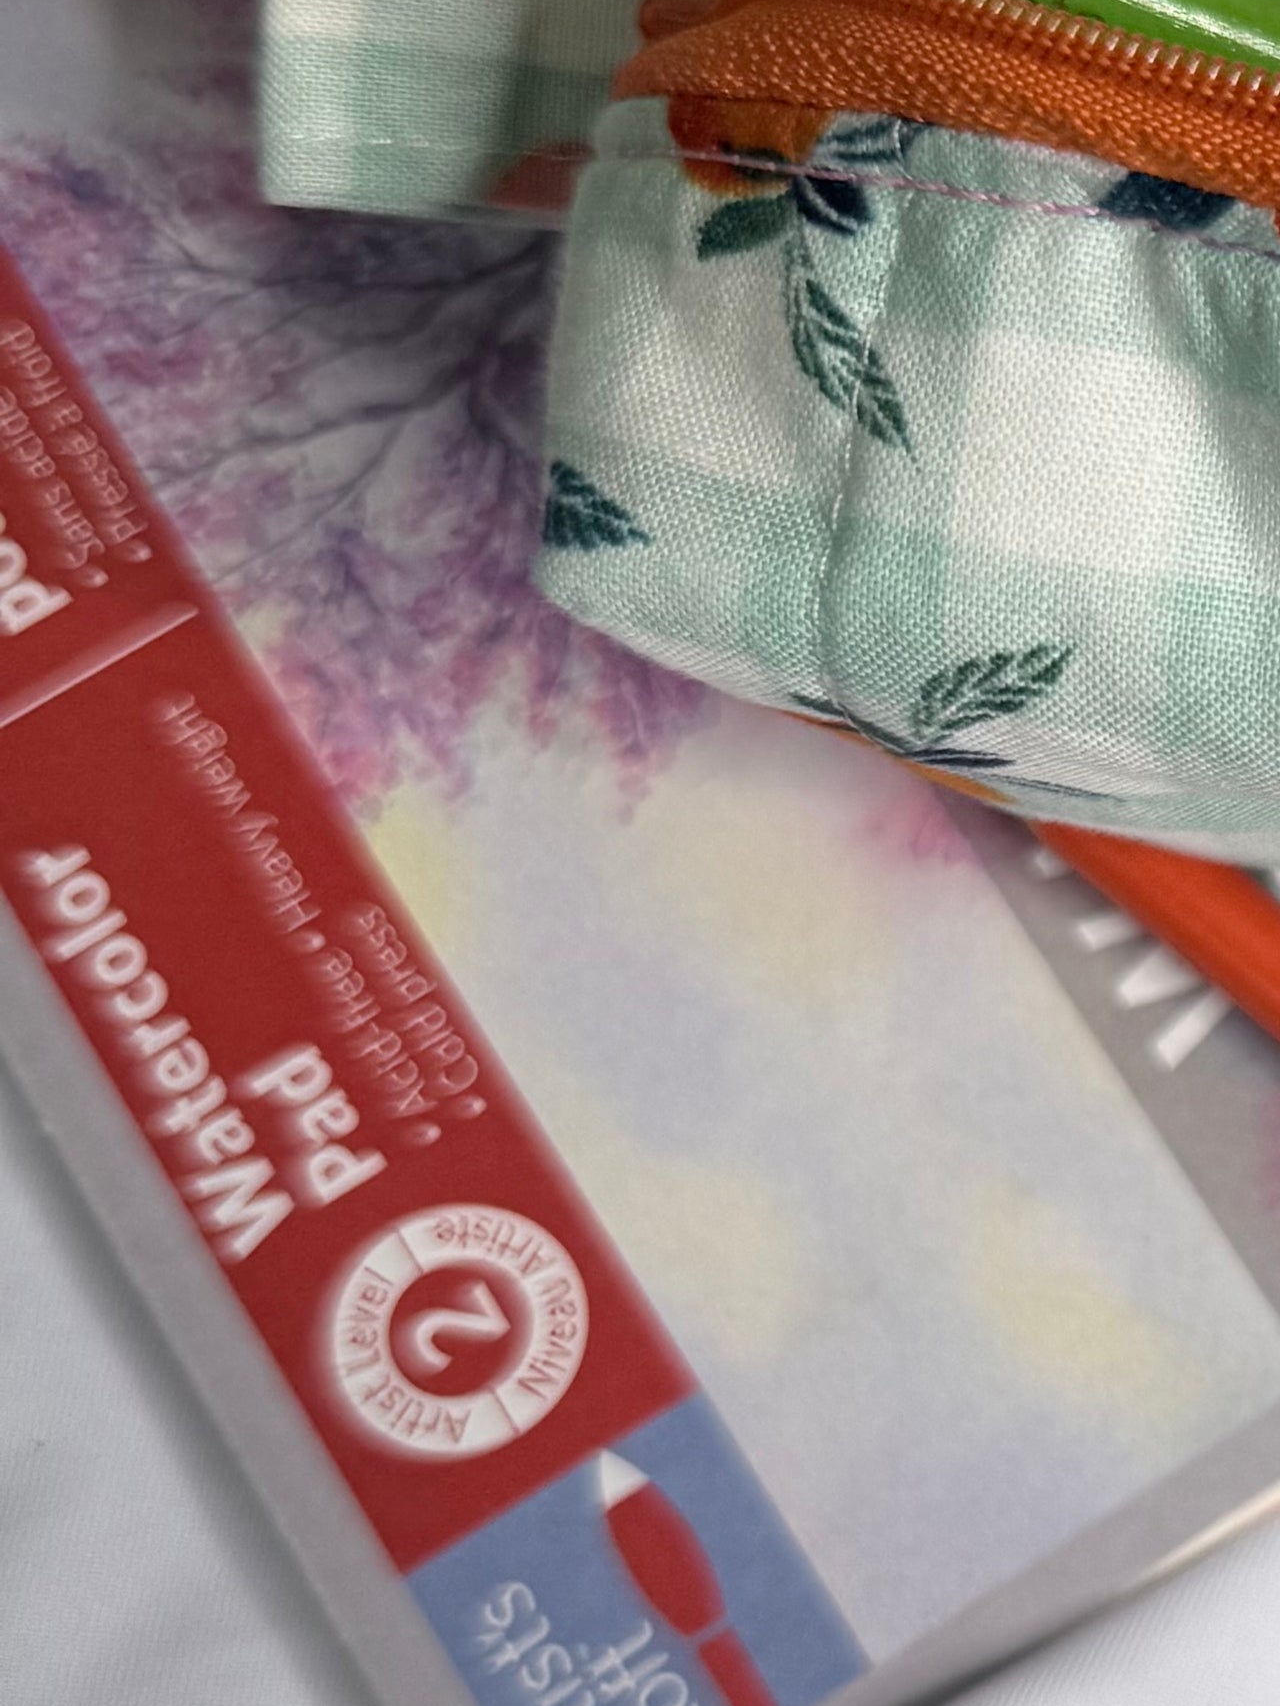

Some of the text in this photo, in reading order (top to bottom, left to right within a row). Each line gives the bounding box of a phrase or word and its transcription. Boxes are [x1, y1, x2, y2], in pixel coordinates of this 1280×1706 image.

[44, 400, 83, 433] à
[39, 482, 106, 568] Sans
[167, 694, 437, 1110] Acid-free Heavy weight
[29, 844, 300, 1261] Watercolor
[352, 903, 483, 1094] Cold press
[247, 1042, 388, 1205] Pad
[342, 1263, 473, 1440] Artist Level
[406, 1278, 511, 1370] 2
[432, 1214, 580, 1398] Niveau Artiste
